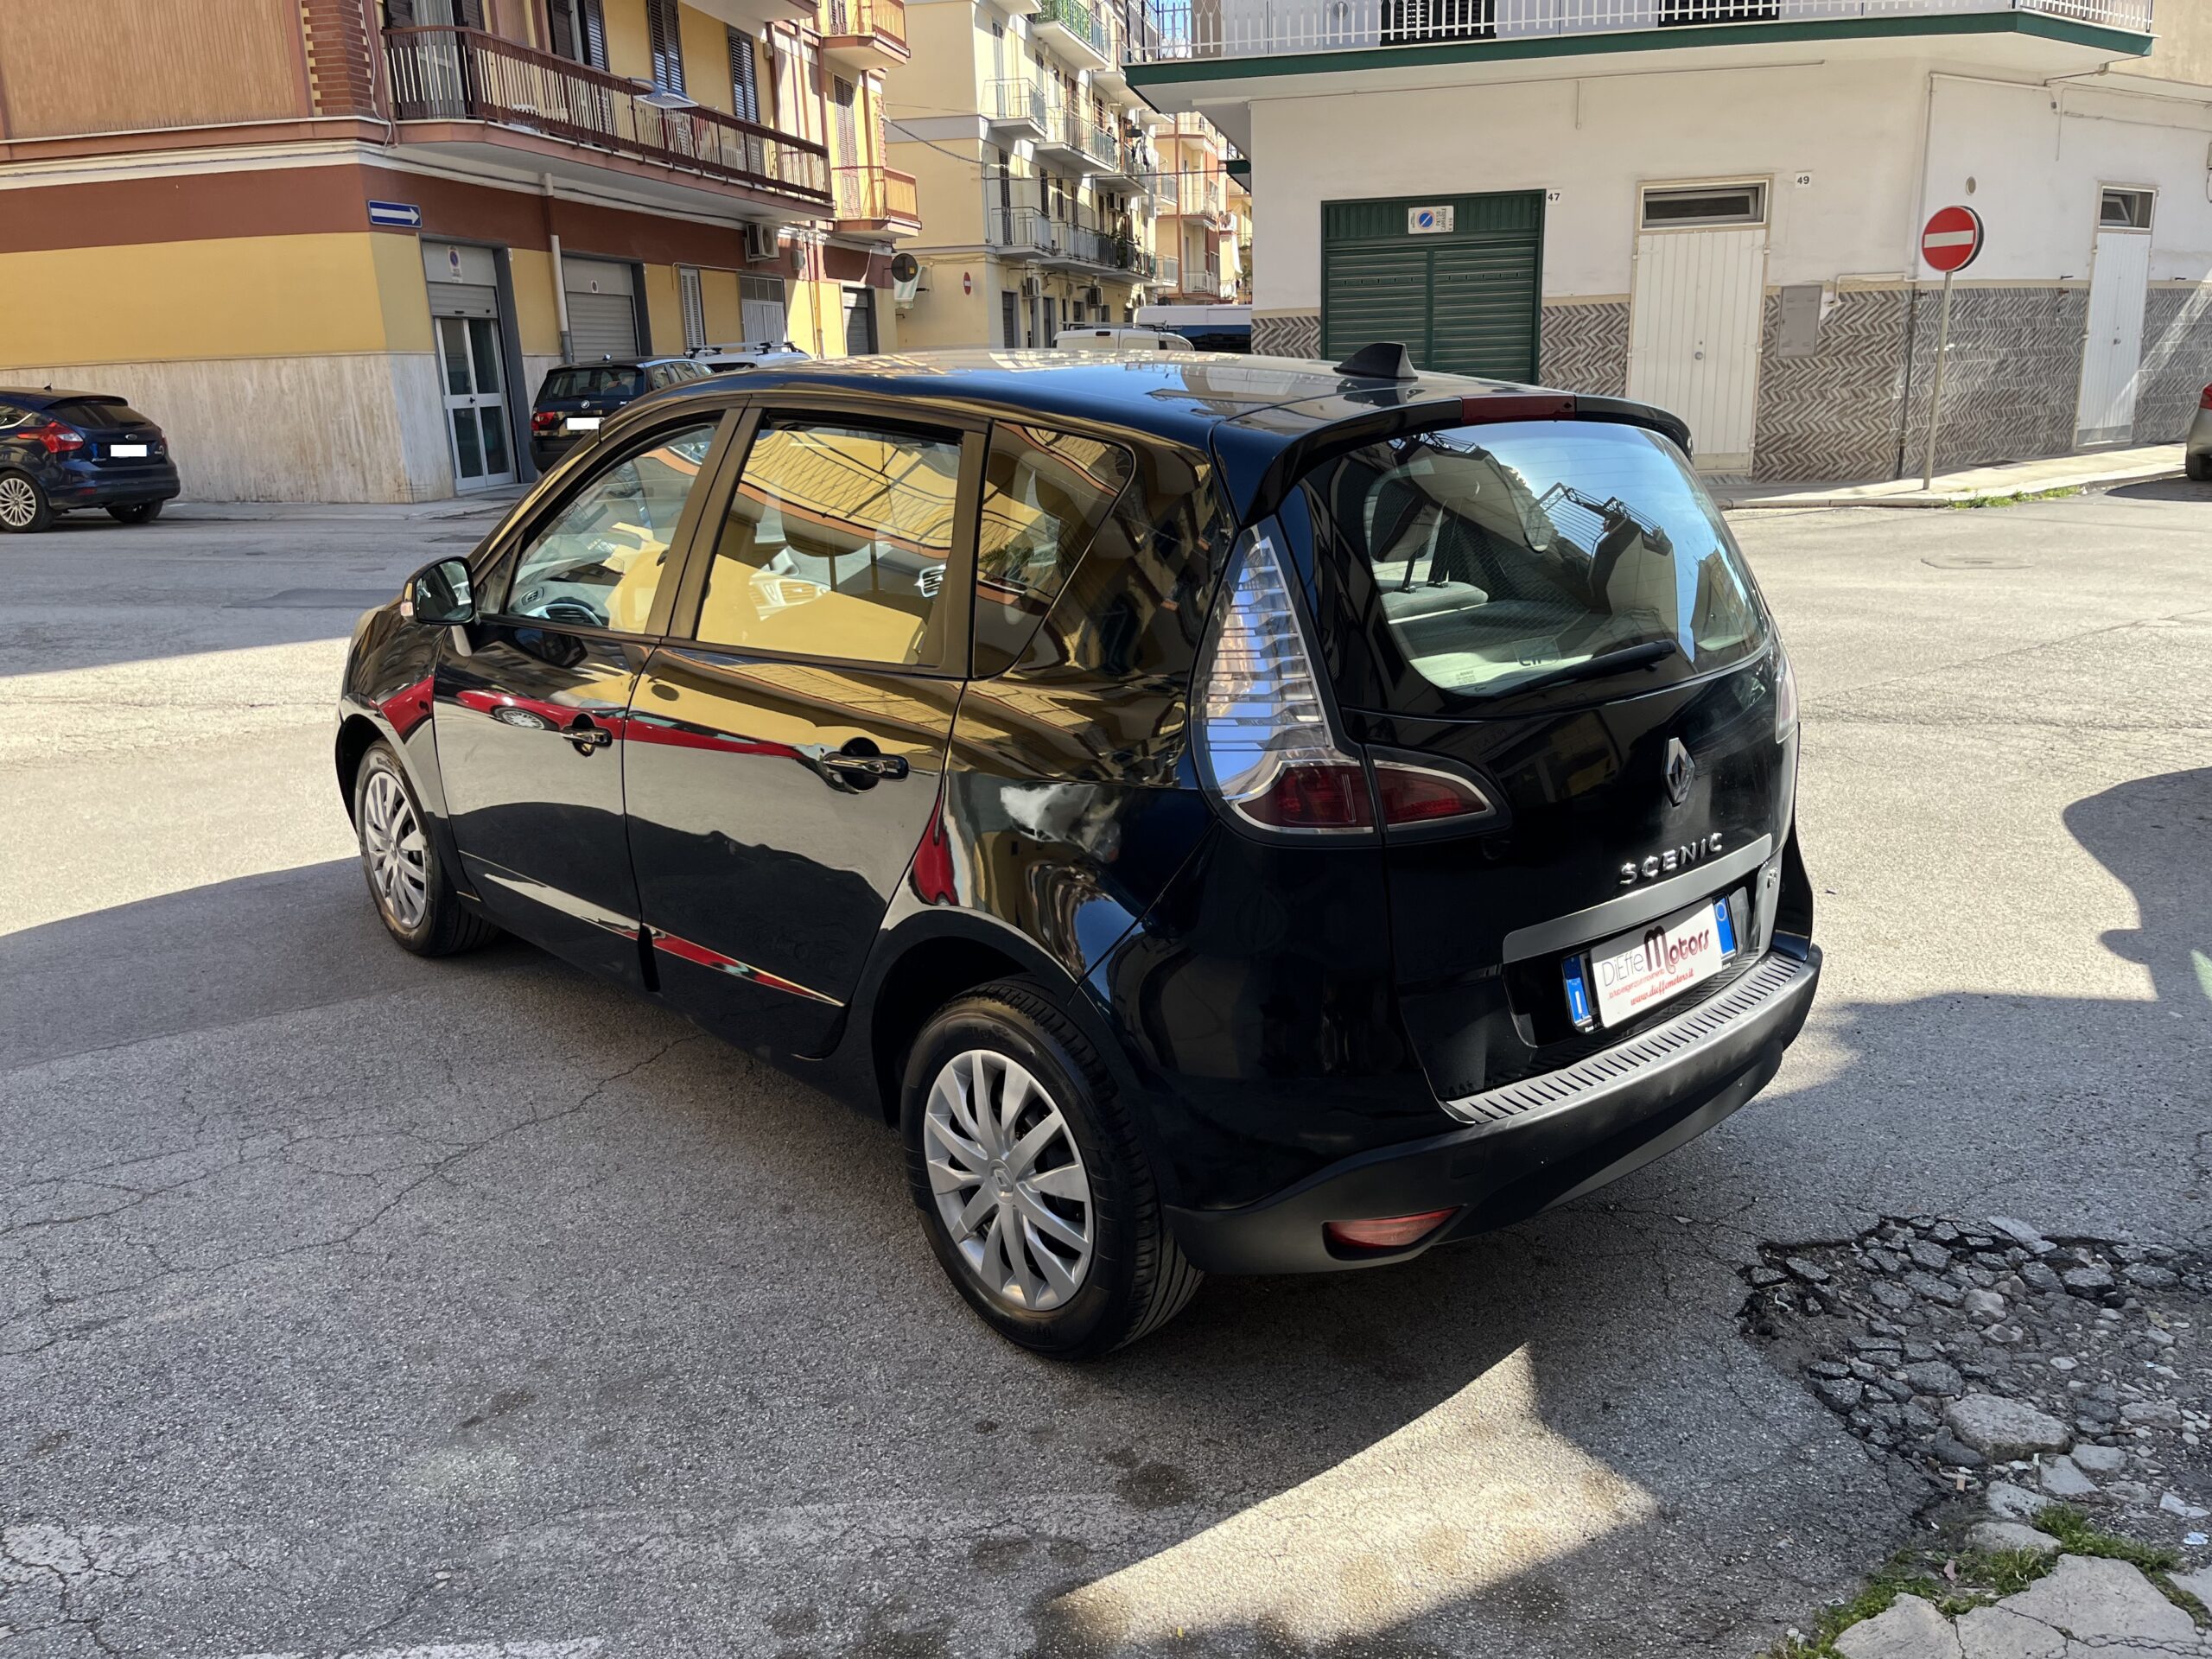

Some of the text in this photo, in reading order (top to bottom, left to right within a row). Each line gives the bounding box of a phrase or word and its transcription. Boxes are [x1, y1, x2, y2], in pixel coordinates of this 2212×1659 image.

[1797, 175, 1809, 185] 49
[1548, 193, 1560, 201] 47
[1619, 832, 1723, 885] SCENIC
[1601, 925, 1710, 987] DiEffe Motors
